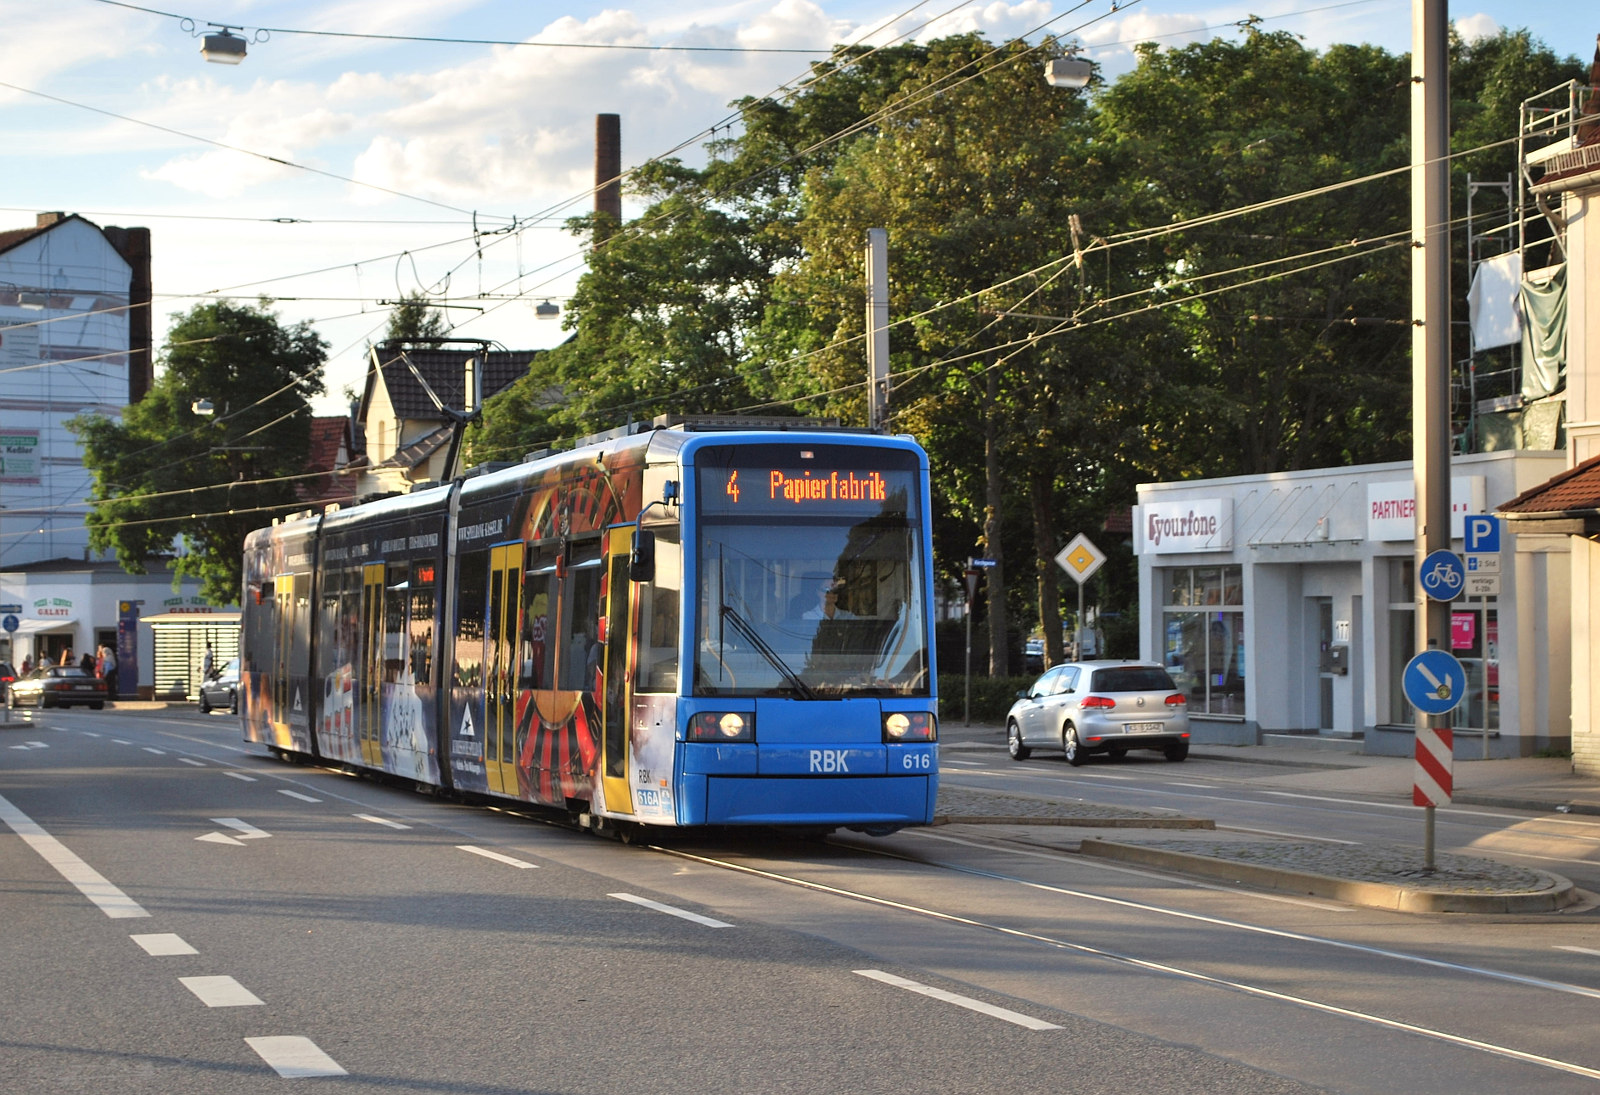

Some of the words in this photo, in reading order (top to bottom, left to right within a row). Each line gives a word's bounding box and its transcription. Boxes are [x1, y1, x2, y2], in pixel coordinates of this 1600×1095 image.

[726, 470, 739, 503] 4
[770, 470, 886, 503] Papierfabrik
[1372, 499, 1415, 519] PARTNER
[1155, 510, 1217, 546] yourfone
[1472, 519, 1492, 548] P
[37, 608, 69, 616] GALATI
[810, 750, 849, 772] RBK
[903, 754, 930, 769] 616
[639, 769, 652, 783] RBK
[638, 790, 659, 806] 616A
